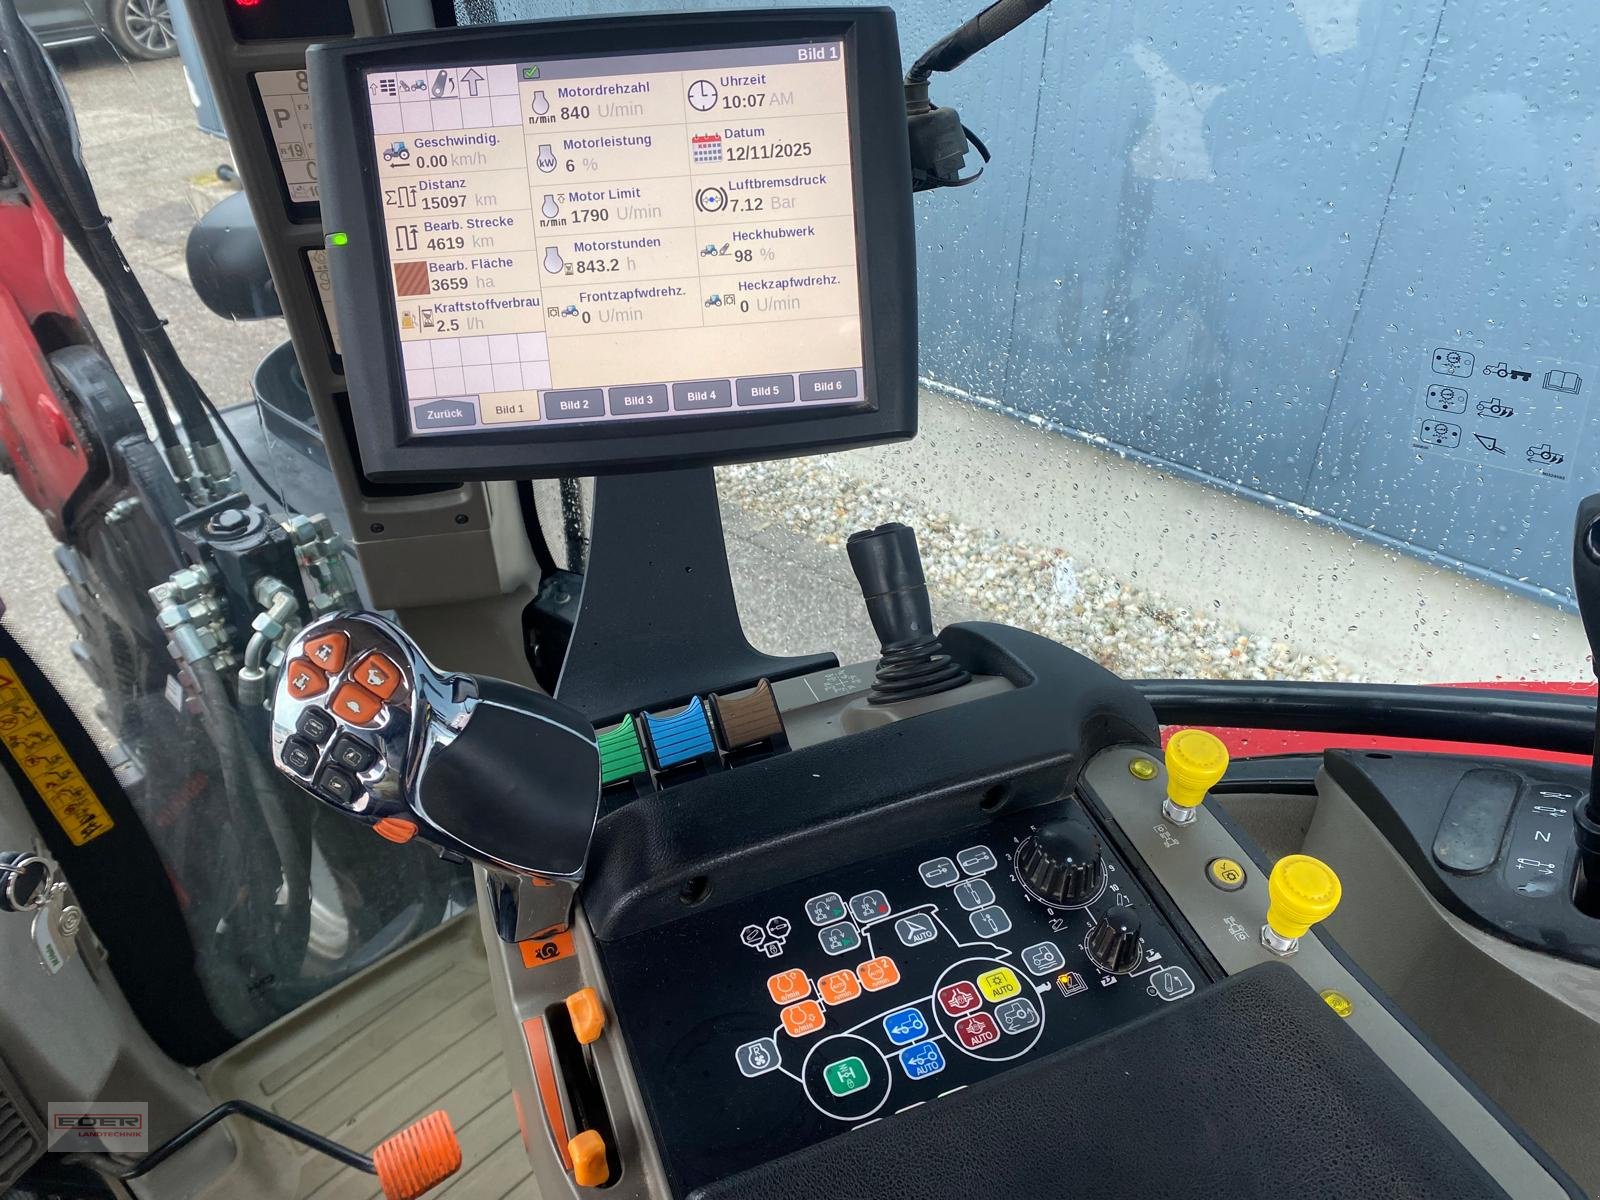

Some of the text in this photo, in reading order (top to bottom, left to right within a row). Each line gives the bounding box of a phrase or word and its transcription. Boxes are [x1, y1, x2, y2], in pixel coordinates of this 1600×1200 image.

[797, 46, 838, 61] Bild 1
[720, 73, 767, 87] Uhrzeit
[558, 81, 650, 98] Motordrehzahl
[722, 91, 794, 109] 10:07 AM
[560, 101, 644, 120] 840 U/min
[273, 108, 291, 129] P
[528, 115, 557, 125] n/min
[414, 132, 501, 149] Geschwindig.
[724, 127, 765, 139] Datum
[563, 135, 652, 150] Motorleistung
[726, 142, 812, 161] 12/11/2025
[416, 151, 487, 169] 0.00 km/h
[539, 158, 555, 168] kW
[565, 158, 598, 172] 6 %
[418, 178, 467, 191] Distanz
[728, 173, 827, 191] Luftbremsdruck
[421, 193, 497, 210] 15097 km
[568, 187, 641, 203] Motor Limit
[730, 196, 797, 213] 7.12 Bar
[571, 205, 662, 224] 1790 U/min
[424, 216, 514, 232] Bearb. Strecke
[540, 218, 567, 227] n/min
[732, 225, 816, 242] Heckhubwerk
[426, 234, 495, 251] 4619 km
[574, 237, 661, 252] Motorstunden
[734, 247, 775, 263] 98 %
[429, 256, 513, 273] Bearb. Fläche
[577, 256, 636, 274] 843.2 h
[431, 275, 495, 291] 3659 ha
[738, 274, 841, 291] Heckzapfwdrehz.
[579, 286, 686, 303] Frontzapfwdrehz.
[434, 297, 540, 314] Kraftstoffverbrau
[740, 296, 801, 313] 0 U/min
[582, 308, 643, 324] 0 U/min
[436, 317, 484, 333] 2.5 l/h
[751, 385, 780, 397] Bild 5
[814, 380, 842, 392] Bild 6
[624, 395, 653, 406] Bild 3
[687, 390, 717, 401] Bild 4
[495, 404, 524, 415] Bild 1
[560, 399, 589, 410] Bild 2
[427, 408, 463, 421] Zurück
[1534, 830, 1551, 842] N
[1009, 874, 1017, 882] 2
[1109, 883, 1120, 892] 10
[913, 930, 933, 943] AUTO
[881, 959, 889, 968] 2
[842, 971, 850, 981] 1
[992, 984, 1014, 997] AUTO
[970, 1031, 994, 1046] AUTO
[915, 1061, 939, 1076] AUTO
